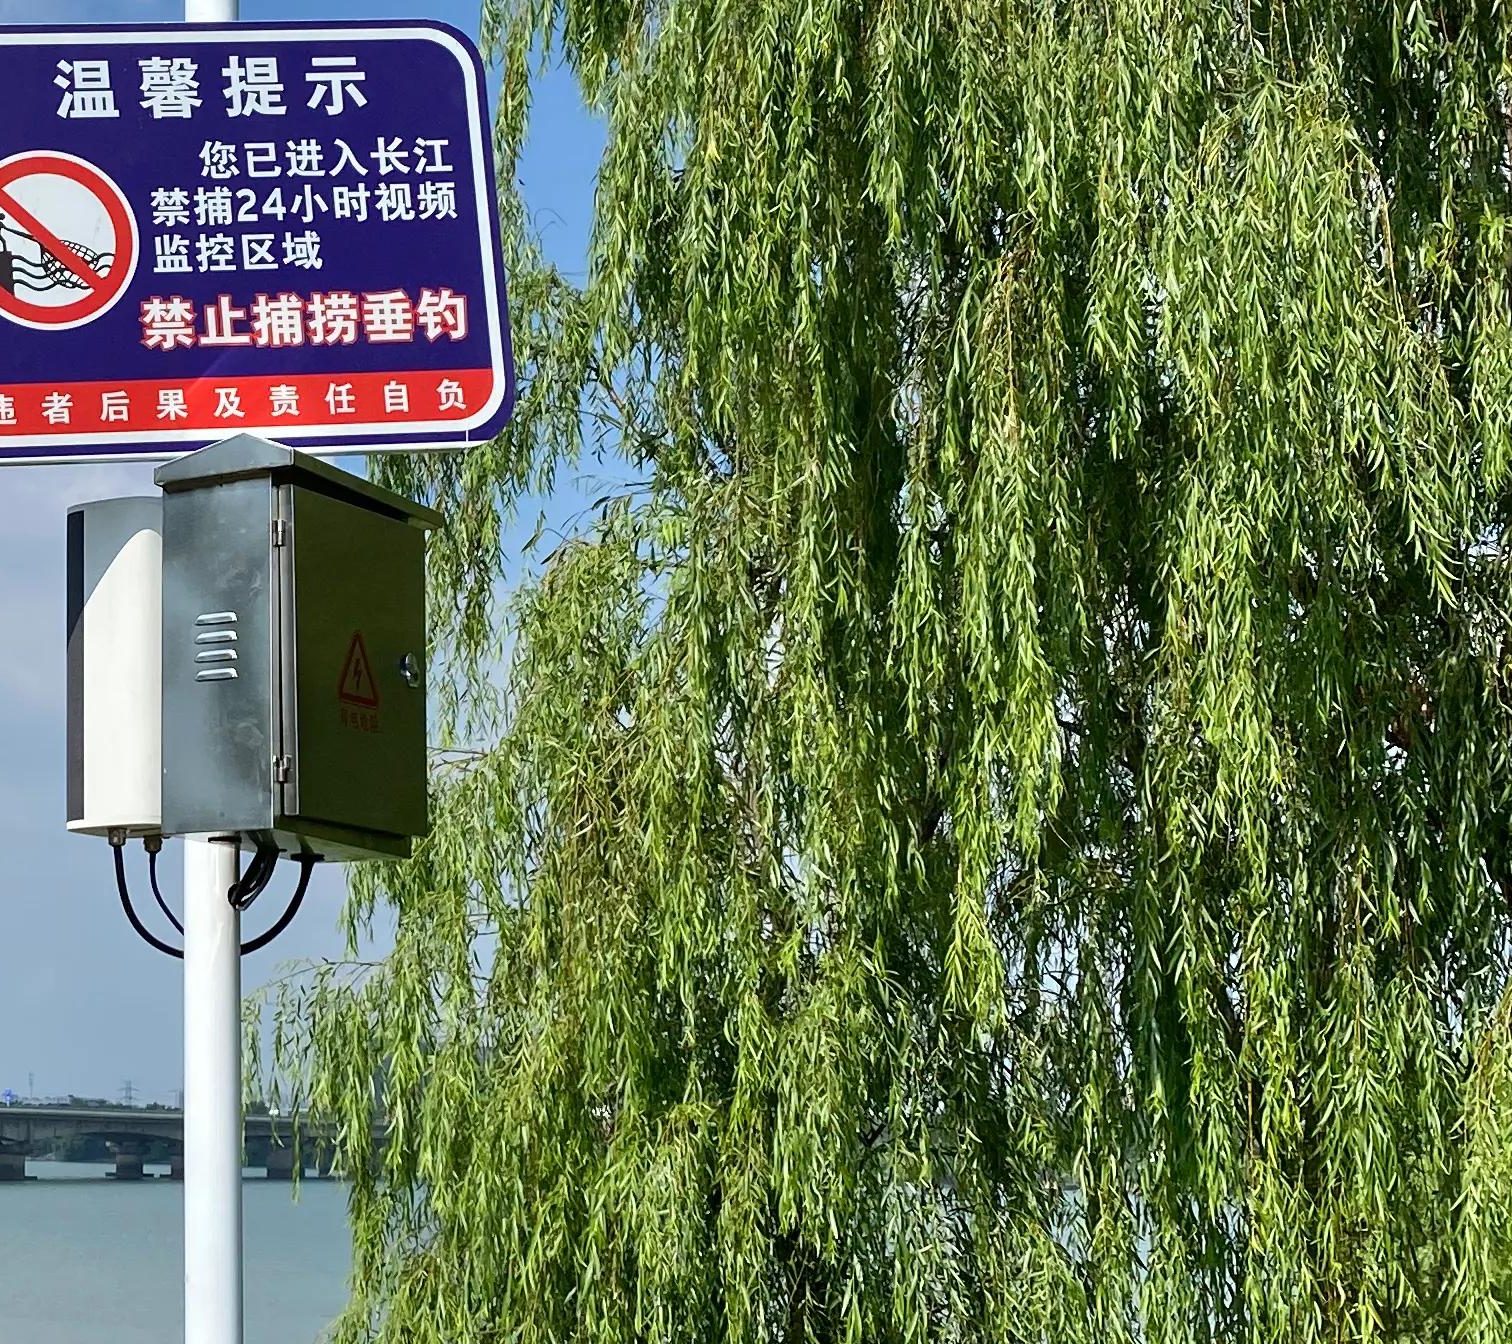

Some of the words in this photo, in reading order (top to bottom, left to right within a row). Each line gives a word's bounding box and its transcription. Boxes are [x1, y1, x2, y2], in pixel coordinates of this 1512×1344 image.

[54, 55, 368, 119] 温馨提示
[198, 136, 453, 180] 您已进入长江
[150, 181, 458, 227] 禁捕24小时视频
[153, 230, 323, 273] 监控区域
[141, 288, 467, 350] 禁止捕捞垂钓
